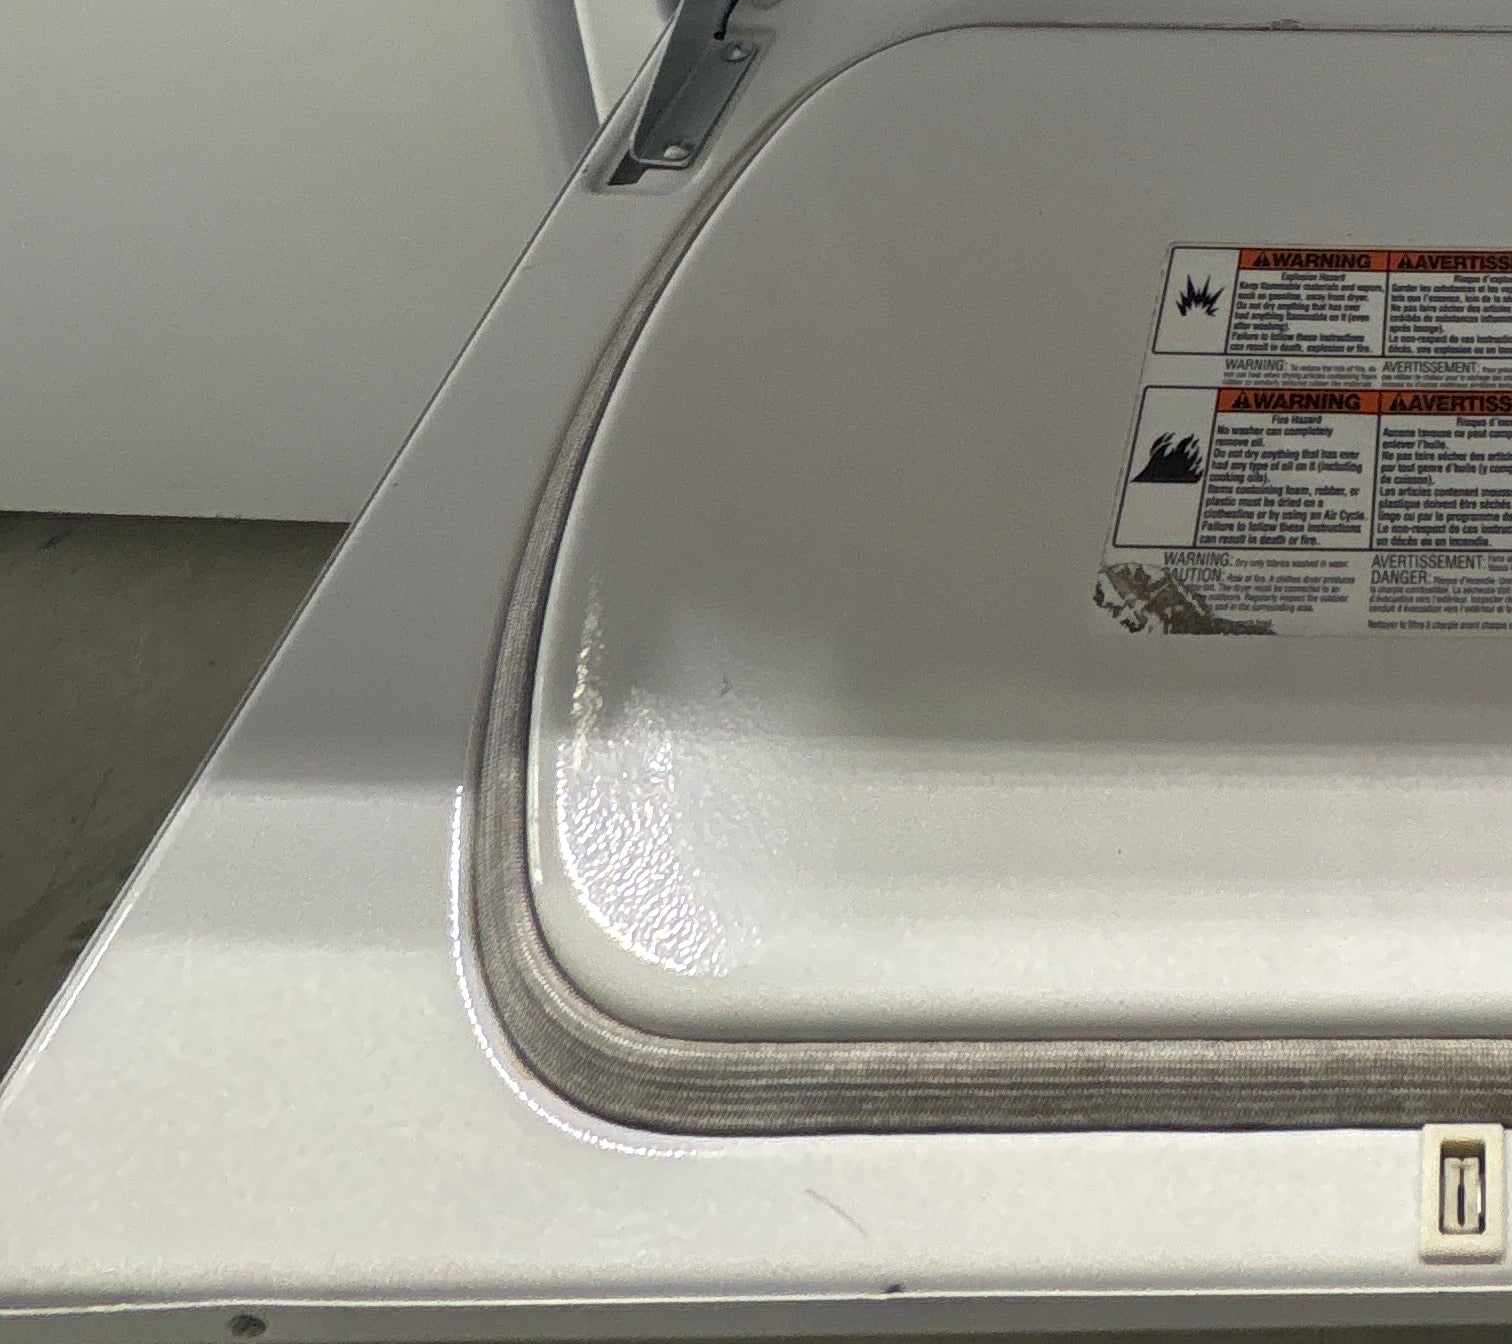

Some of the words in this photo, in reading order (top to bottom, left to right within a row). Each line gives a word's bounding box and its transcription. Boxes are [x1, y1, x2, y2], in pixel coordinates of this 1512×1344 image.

[1273, 253, 1371, 268] WARNING
[1225, 359, 1288, 371] WARNING:
[1382, 361, 1481, 373] AVERTISSEMENT:
[1253, 393, 1361, 410] WARNING
[1164, 551, 1234, 567] WARNING:
[1371, 554, 1488, 570] AVERTISSEMENT:
[1371, 570, 1431, 585] DANGER:
